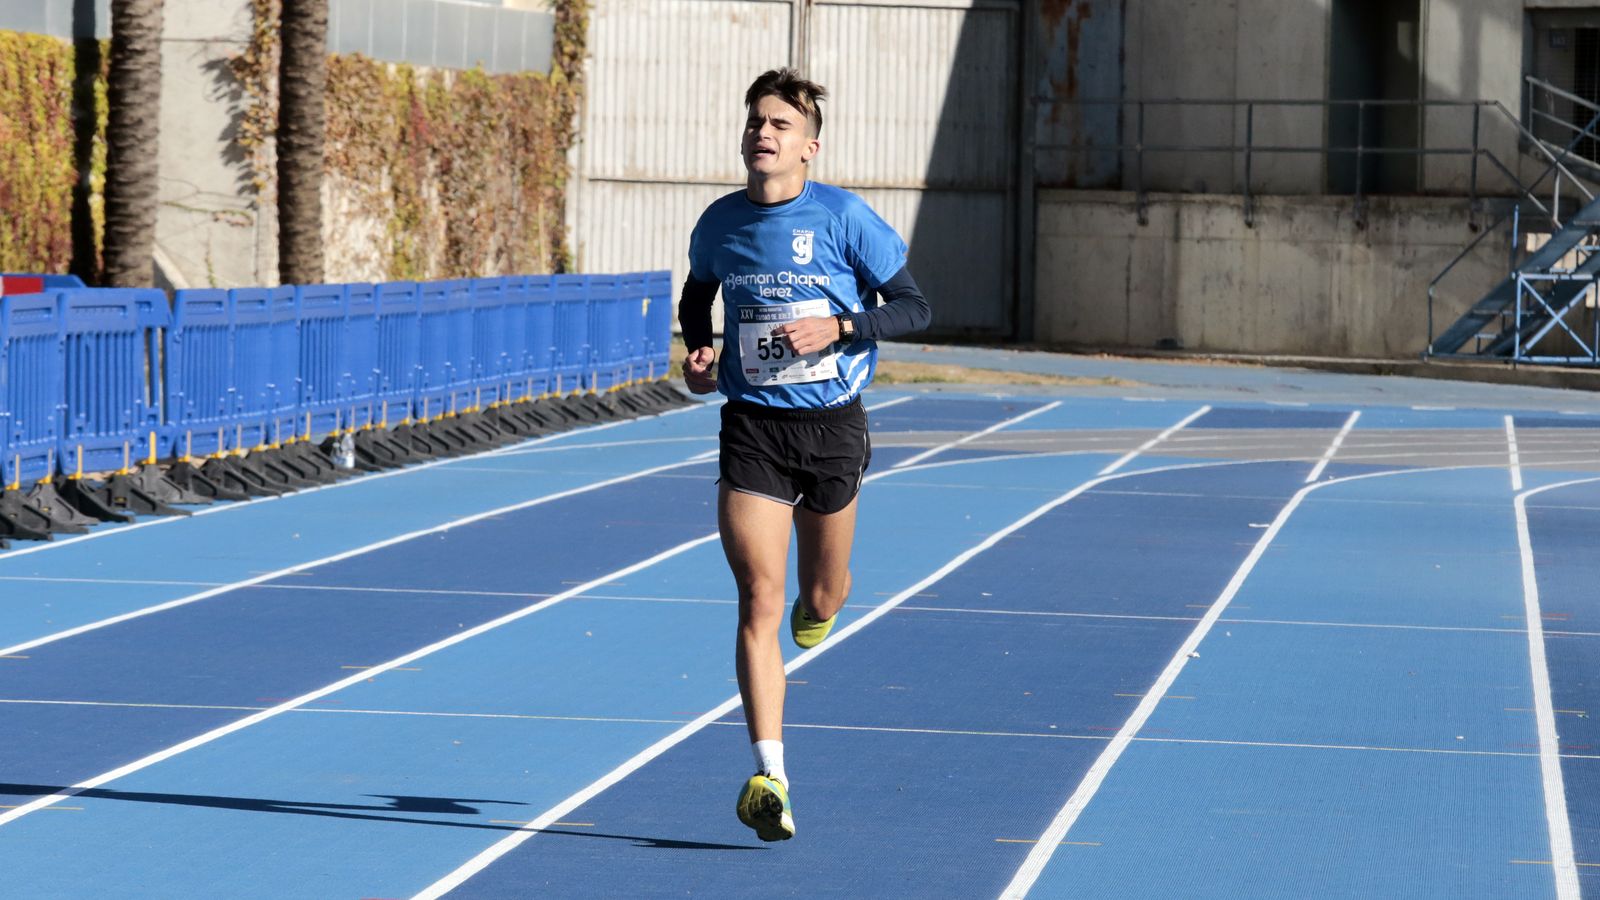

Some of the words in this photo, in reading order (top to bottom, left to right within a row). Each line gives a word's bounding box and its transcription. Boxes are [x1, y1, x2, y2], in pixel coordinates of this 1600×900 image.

[777, 271, 830, 287] Chapin
[760, 286, 793, 297] Jerez
[740, 308, 754, 320] XXV
